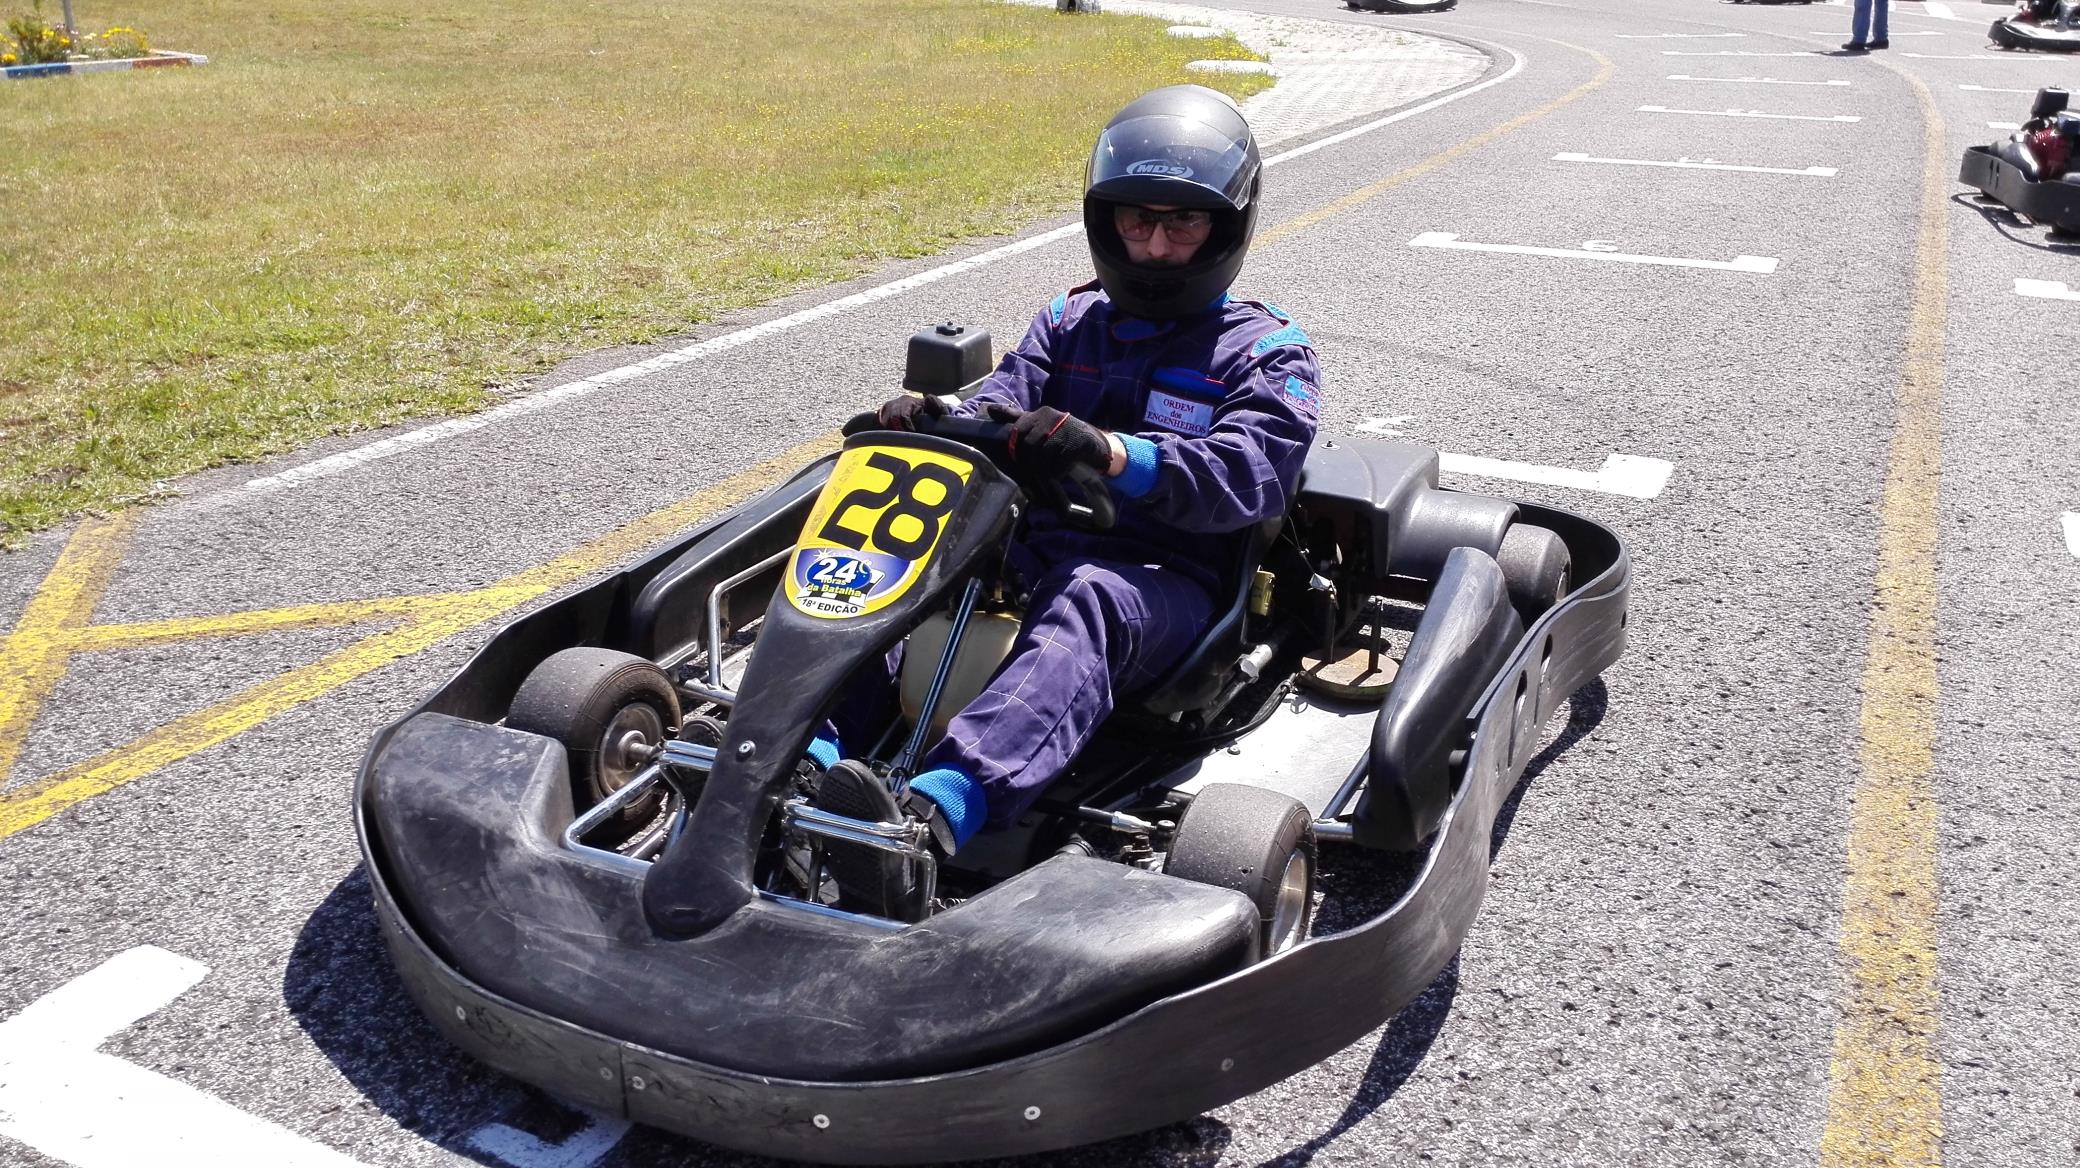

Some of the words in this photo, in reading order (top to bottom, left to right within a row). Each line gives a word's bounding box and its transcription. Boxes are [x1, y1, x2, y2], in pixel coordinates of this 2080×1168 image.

[1136, 164, 1186, 175] MDS
[1163, 398, 1195, 413] ORDEM
[1170, 410, 1183, 419] dos
[1147, 411, 1207, 434] ENGENHEIROS
[818, 451, 965, 560] 28
[812, 557, 859, 583] 24
[820, 576, 847, 585] horas
[807, 583, 820, 592] da
[821, 584, 862, 597] Batalha
[802, 598, 817, 608] 18ª
[817, 602, 859, 614] EDIÇÃO
